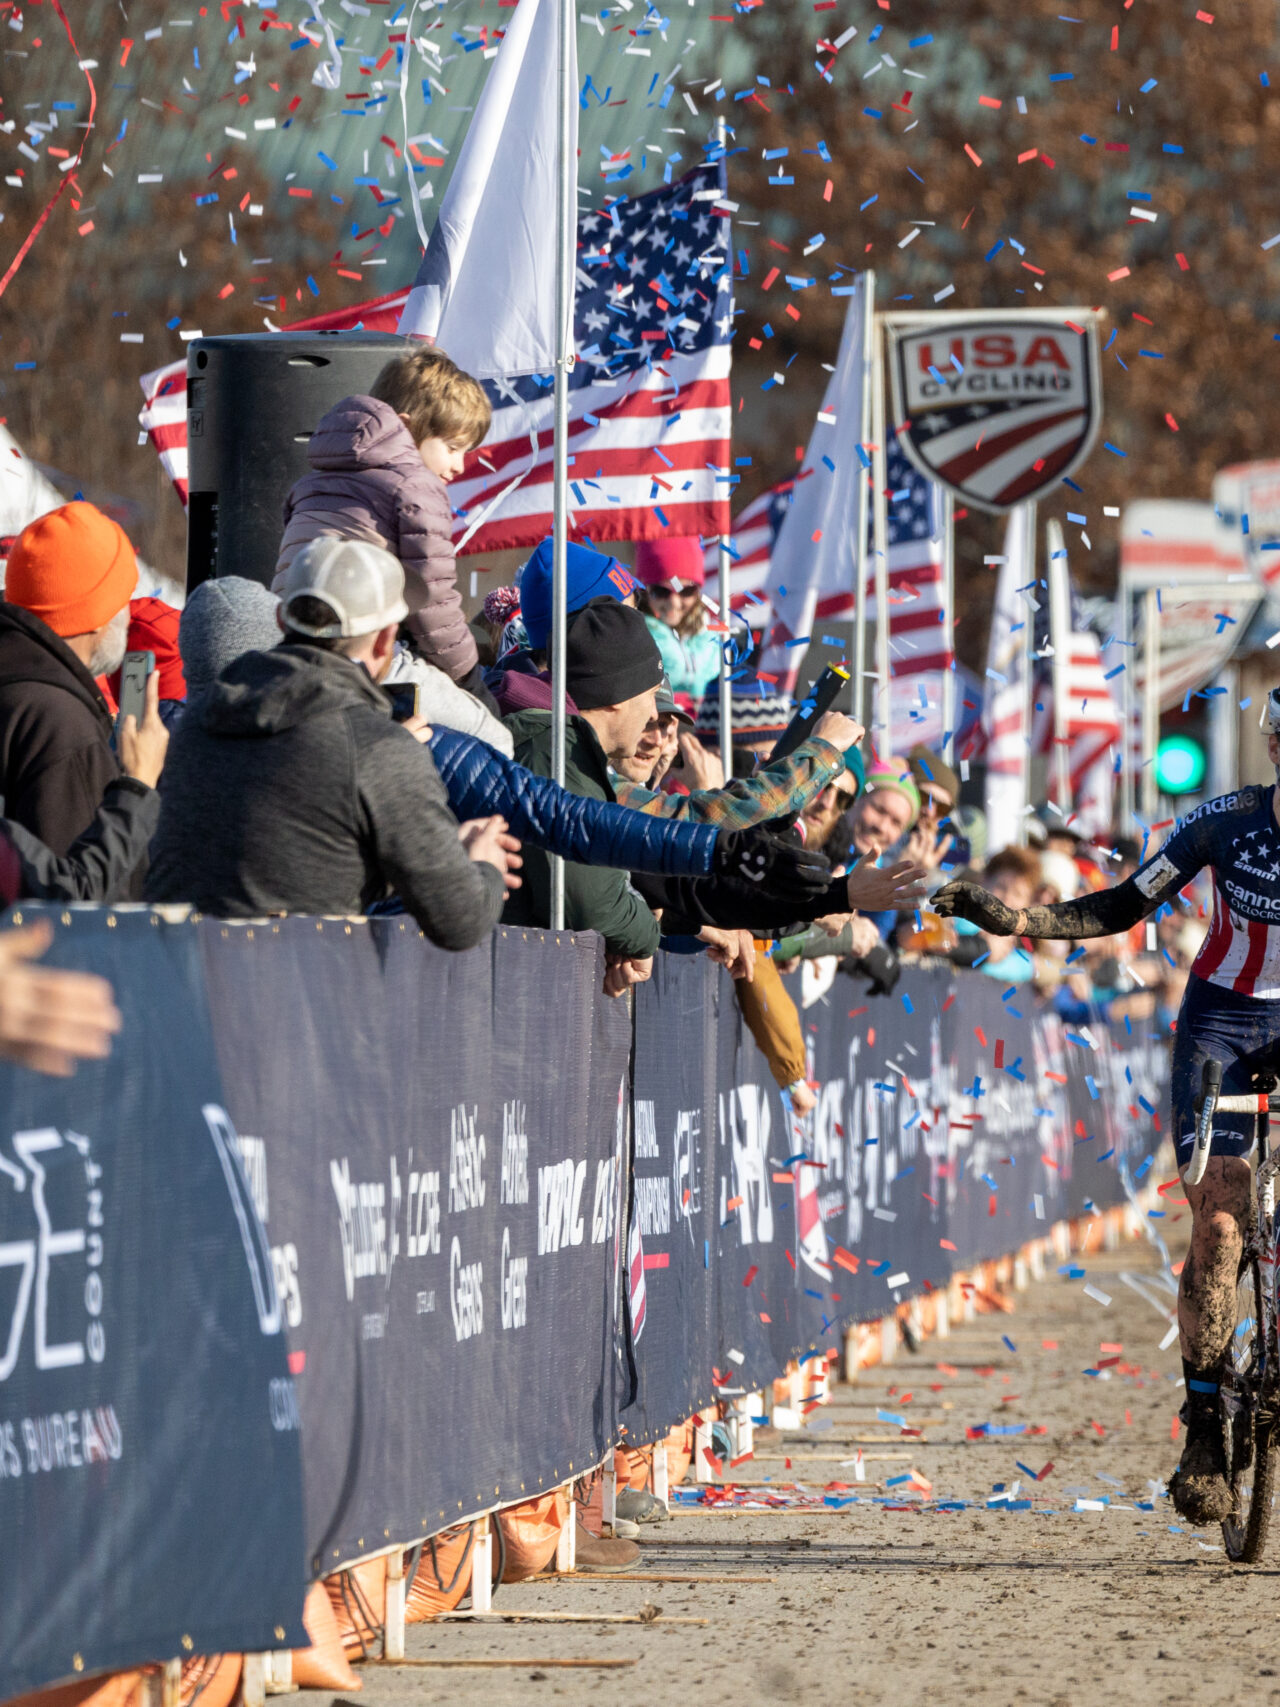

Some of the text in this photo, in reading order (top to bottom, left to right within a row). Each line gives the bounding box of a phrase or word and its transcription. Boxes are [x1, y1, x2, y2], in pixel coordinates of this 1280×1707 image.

[917, 333, 1072, 376] USA
[919, 372, 1072, 398] CYCLING
[1233, 860, 1277, 881] SRAM
